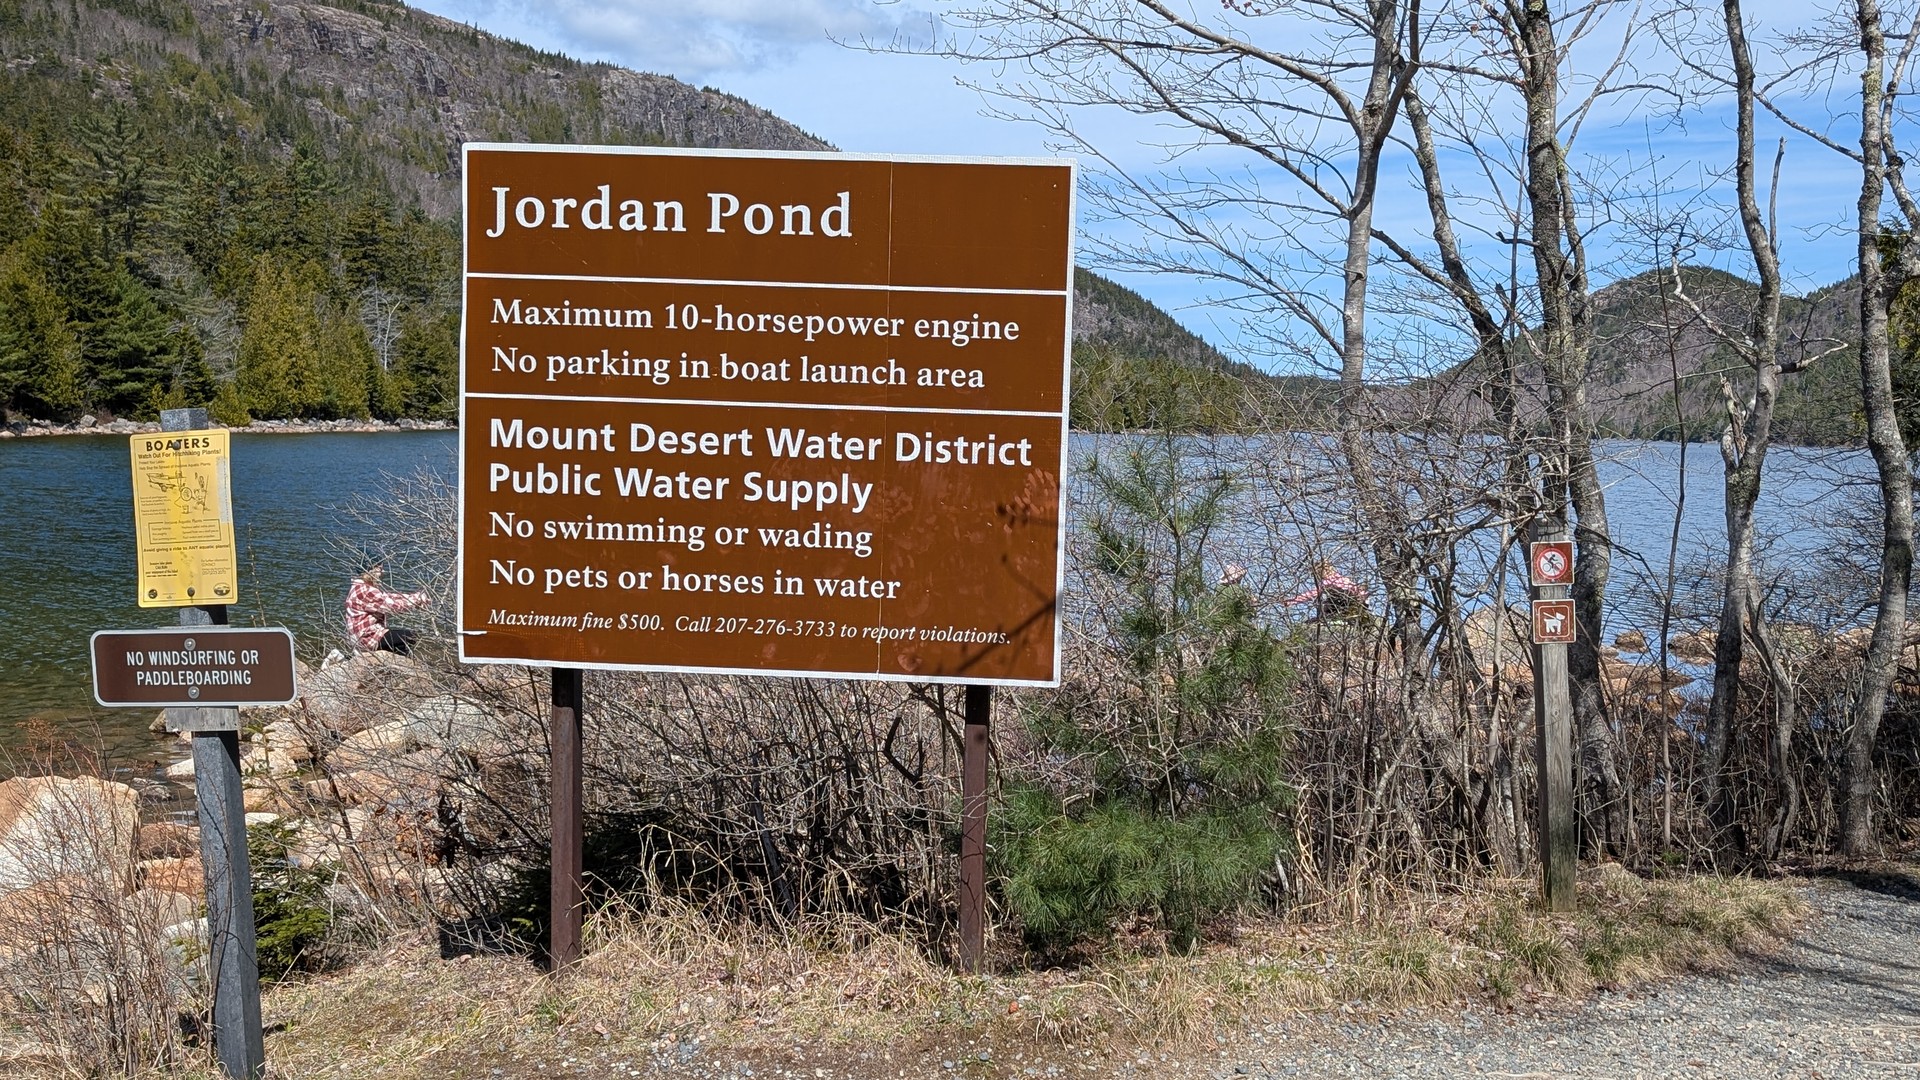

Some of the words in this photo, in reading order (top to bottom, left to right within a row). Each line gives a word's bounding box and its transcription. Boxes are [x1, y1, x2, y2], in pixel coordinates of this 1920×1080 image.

[486, 184, 687, 238] Jordan
[707, 191, 853, 238] Pond
[490, 298, 653, 328] Maximum
[665, 303, 905, 342] 10-horsepower
[914, 313, 1020, 347] engine
[491, 346, 537, 373] No
[546, 349, 671, 385] parking
[679, 352, 711, 379] in
[719, 353, 791, 382] boat
[800, 355, 908, 385] launch
[917, 367, 985, 388] area
[146, 437, 210, 452] BOATERS
[490, 418, 616, 452] Mount
[630, 423, 753, 457] Desert
[765, 427, 882, 461] Water
[896, 431, 1032, 466] District
[490, 462, 601, 496] Public
[613, 467, 730, 500] Water
[743, 471, 874, 512] Supply
[488, 511, 534, 538] No
[544, 514, 706, 551] swimming
[714, 526, 749, 545] or
[757, 522, 873, 558] wading
[489, 559, 535, 586] No
[543, 565, 608, 594] pets
[618, 571, 653, 590] or
[661, 564, 764, 594] horses
[774, 569, 805, 595] in
[813, 575, 901, 599] water
[487, 609, 578, 628] Maximum
[578, 611, 613, 632] fine
[617, 613, 664, 631] $500.
[675, 616, 711, 633] Call
[715, 617, 835, 637] 207-276-3733
[840, 624, 857, 638] to
[862, 626, 916, 645] report
[919, 625, 1010, 644] violations.
[126, 652, 143, 666] NO
[148, 650, 235, 666] WINDSURFING
[241, 650, 259, 665] OR
[137, 670, 251, 686] PADDLEBOARDING
